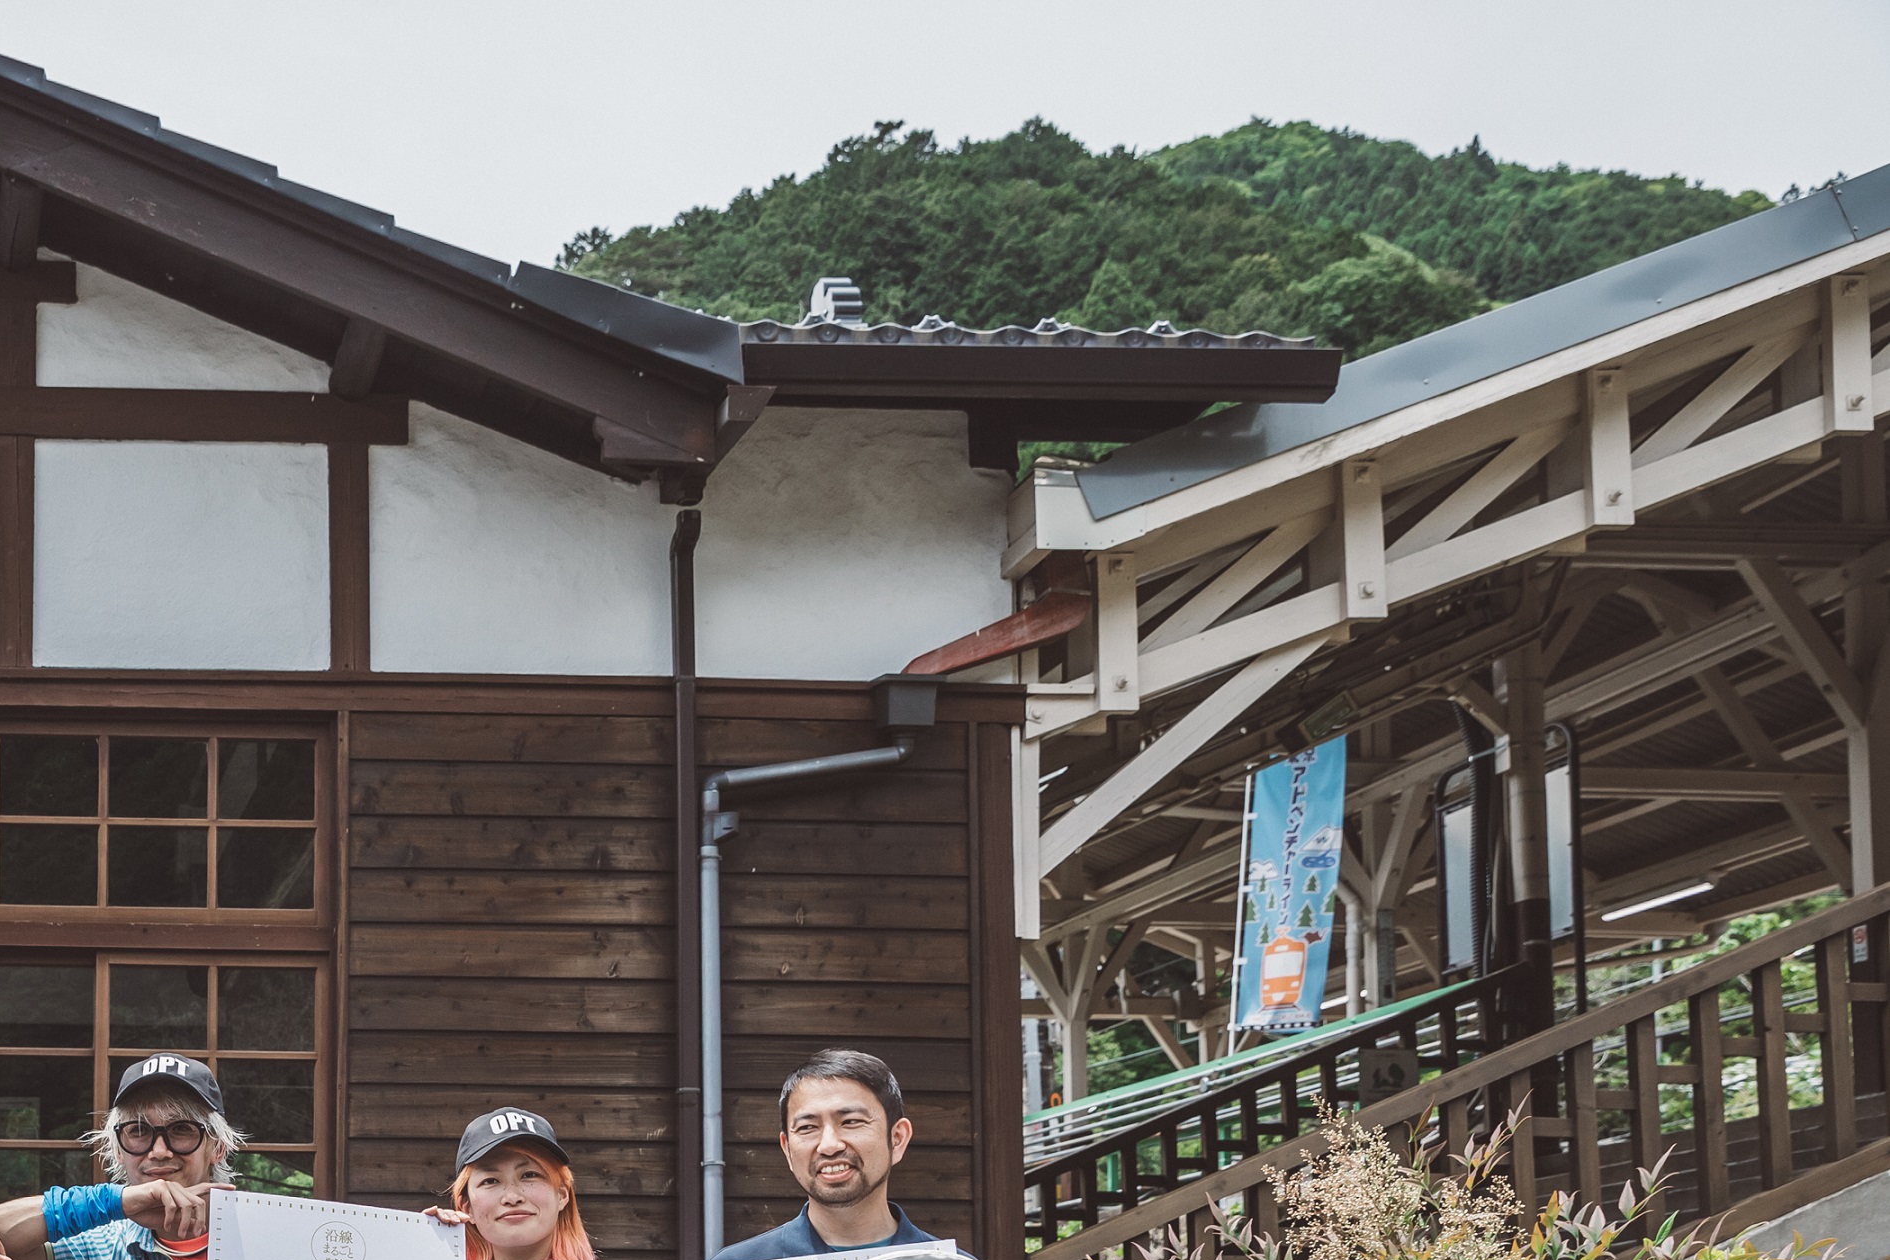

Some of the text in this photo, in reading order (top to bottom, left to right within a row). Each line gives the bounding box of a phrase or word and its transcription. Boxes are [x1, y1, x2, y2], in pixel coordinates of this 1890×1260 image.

[143, 1056, 189, 1076] OPT
[490, 1112, 536, 1134] OPT
[325, 1228, 353, 1244] 沿線
[322, 1243, 354, 1259] まるごと
